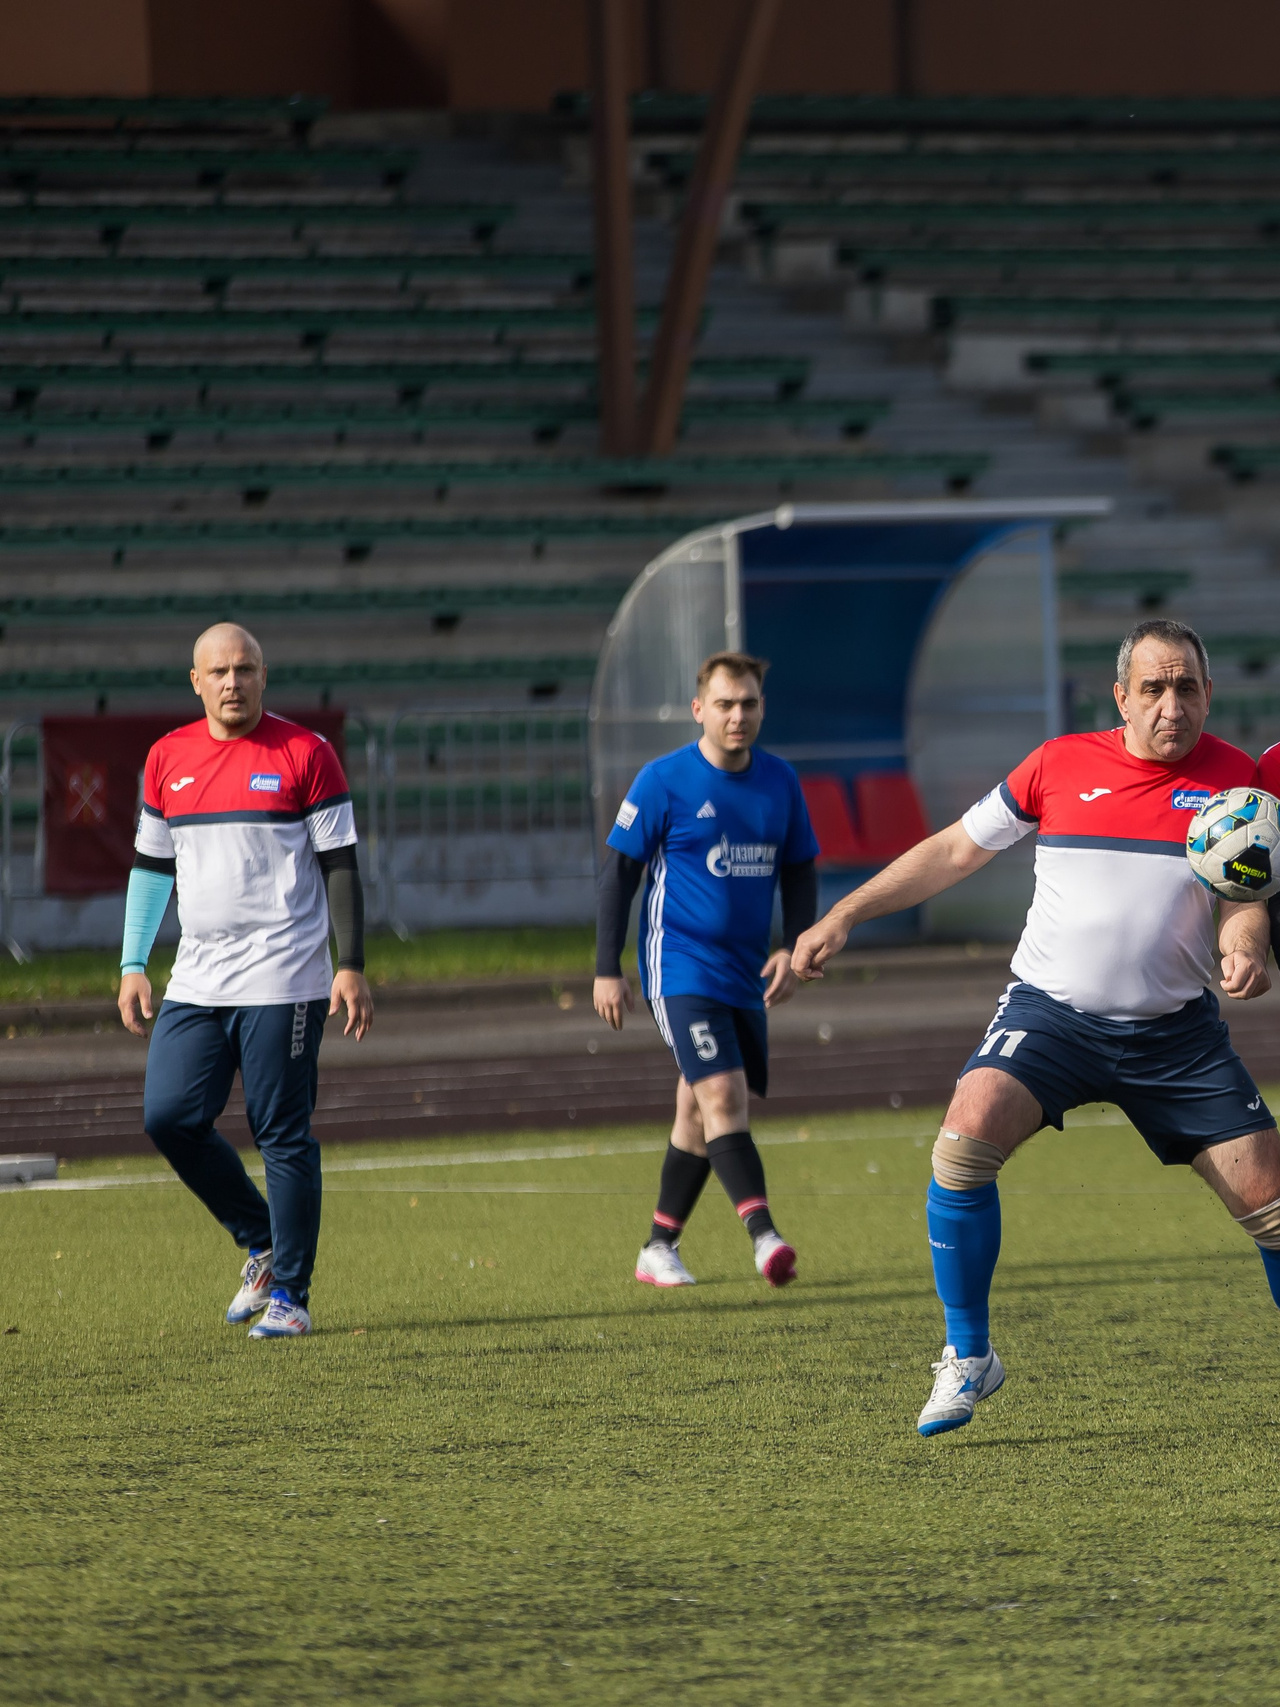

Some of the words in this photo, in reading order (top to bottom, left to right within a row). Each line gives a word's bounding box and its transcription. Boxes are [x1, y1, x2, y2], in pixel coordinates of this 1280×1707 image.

[1232, 861, 1267, 880] VISION
[290, 1001, 308, 1059] oma
[689, 1020, 719, 1061] 5
[978, 1028, 1028, 1058] 11
